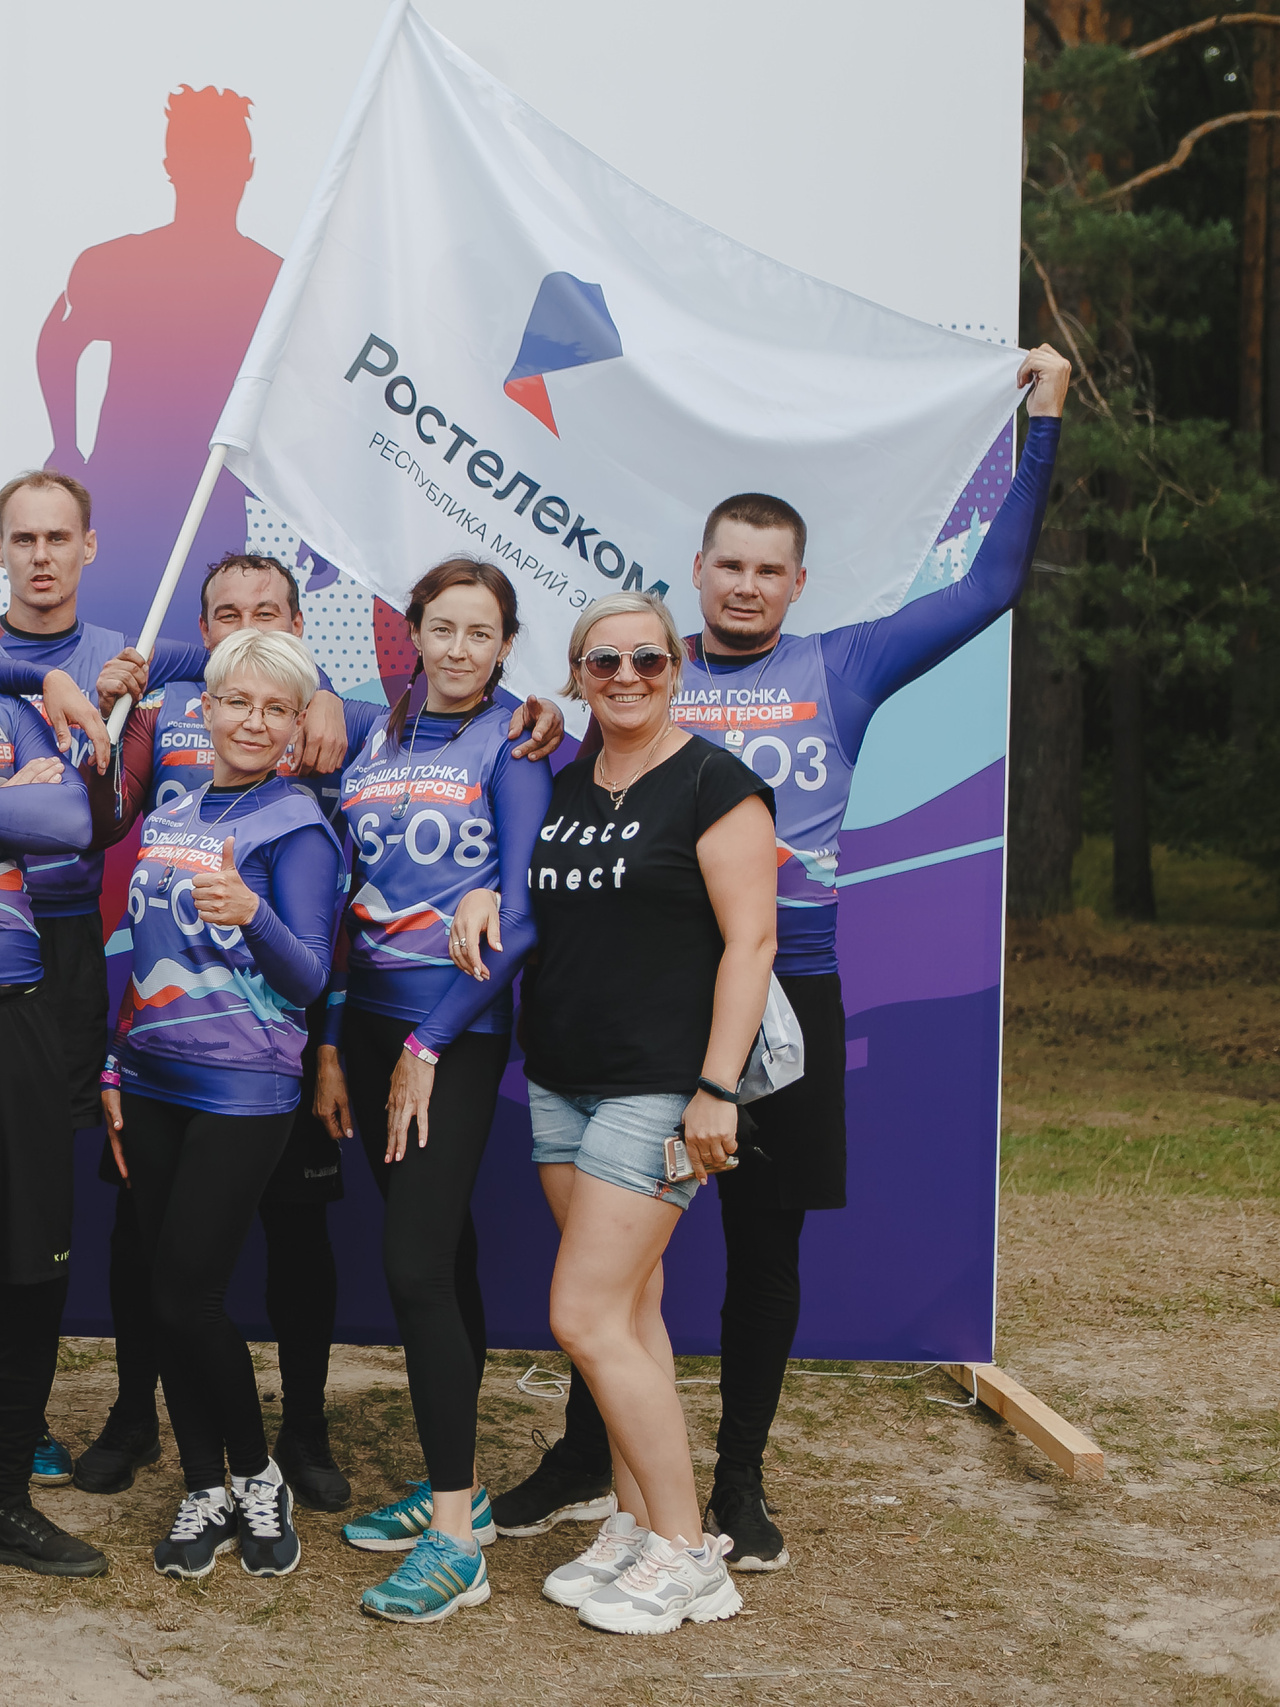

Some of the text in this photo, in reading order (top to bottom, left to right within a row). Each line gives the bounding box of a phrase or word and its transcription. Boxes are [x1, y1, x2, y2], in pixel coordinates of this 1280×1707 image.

[344, 333, 670, 603] Ростелеком
[368, 431, 488, 542] РЕСПУБЛИКА
[490, 534, 569, 597] МАРИЙ
[726, 688, 791, 705] ГОНКА
[726, 705, 793, 721] ГЕРОЕВ
[161, 732, 215, 748] БОЛЬ
[345, 765, 469, 793] БОЛЬШАЯ ГОНКА
[361, 781, 467, 801] ВРЕМЯ ГЕРОЕВ
[348, 809, 491, 868] 6-08
[540, 815, 640, 845] disco
[198, 834, 224, 854] ГОН
[147, 847, 222, 872] ВРЕМЯ ГЕРОЕ
